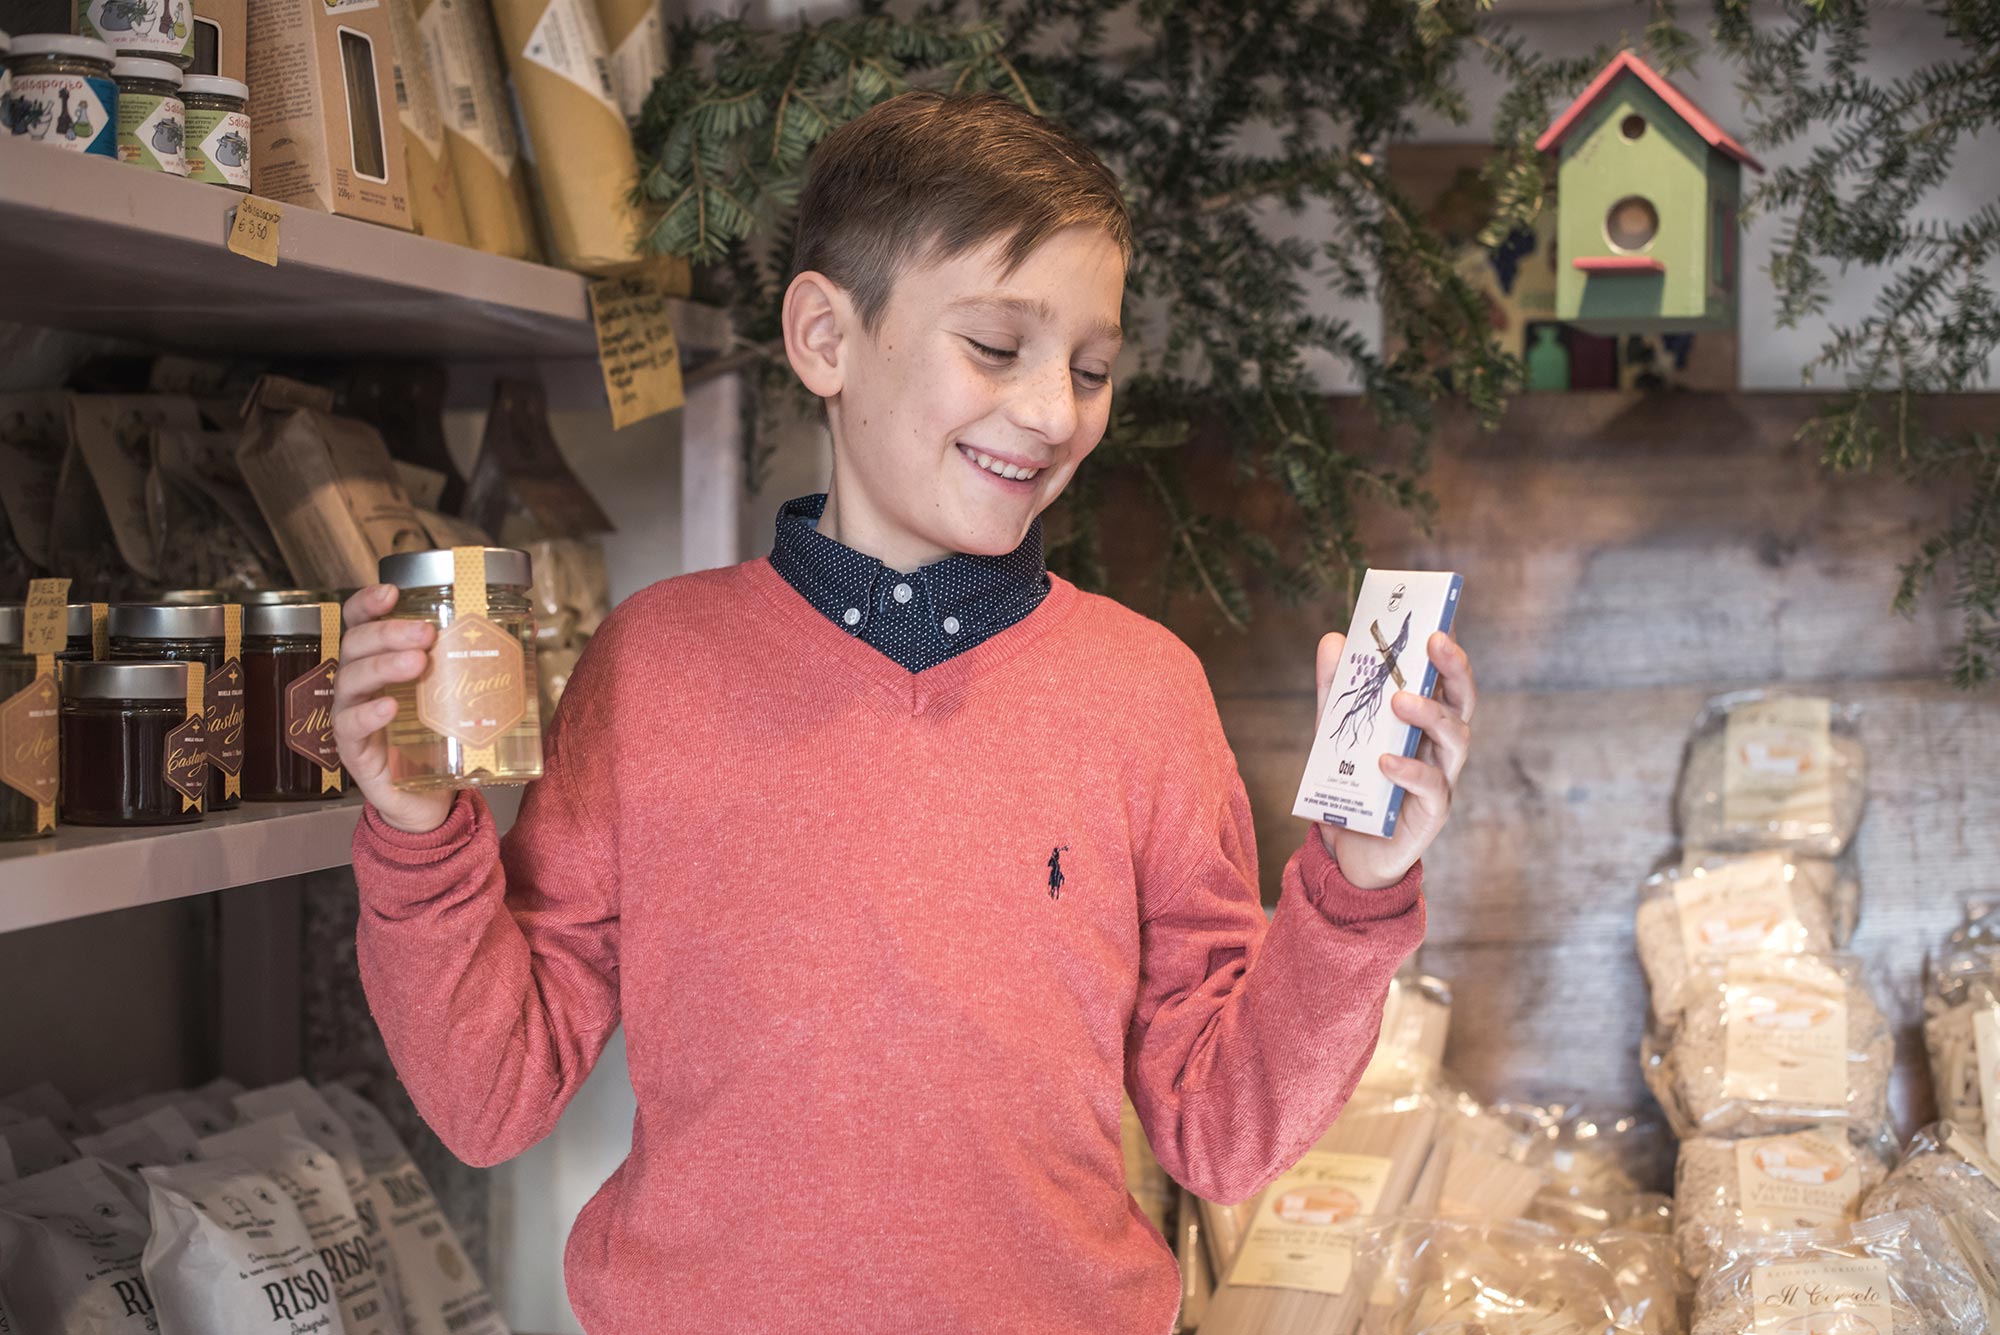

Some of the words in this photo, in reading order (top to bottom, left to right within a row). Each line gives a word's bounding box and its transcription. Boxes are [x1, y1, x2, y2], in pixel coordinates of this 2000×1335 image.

[228, 115, 250, 130] Salsa
[433, 670, 512, 707] Acacia
[1338, 759, 1356, 776] Ozio
[320, 1235, 372, 1284] RISO
[111, 1276, 154, 1317] RI
[262, 1269, 330, 1322] RISO
